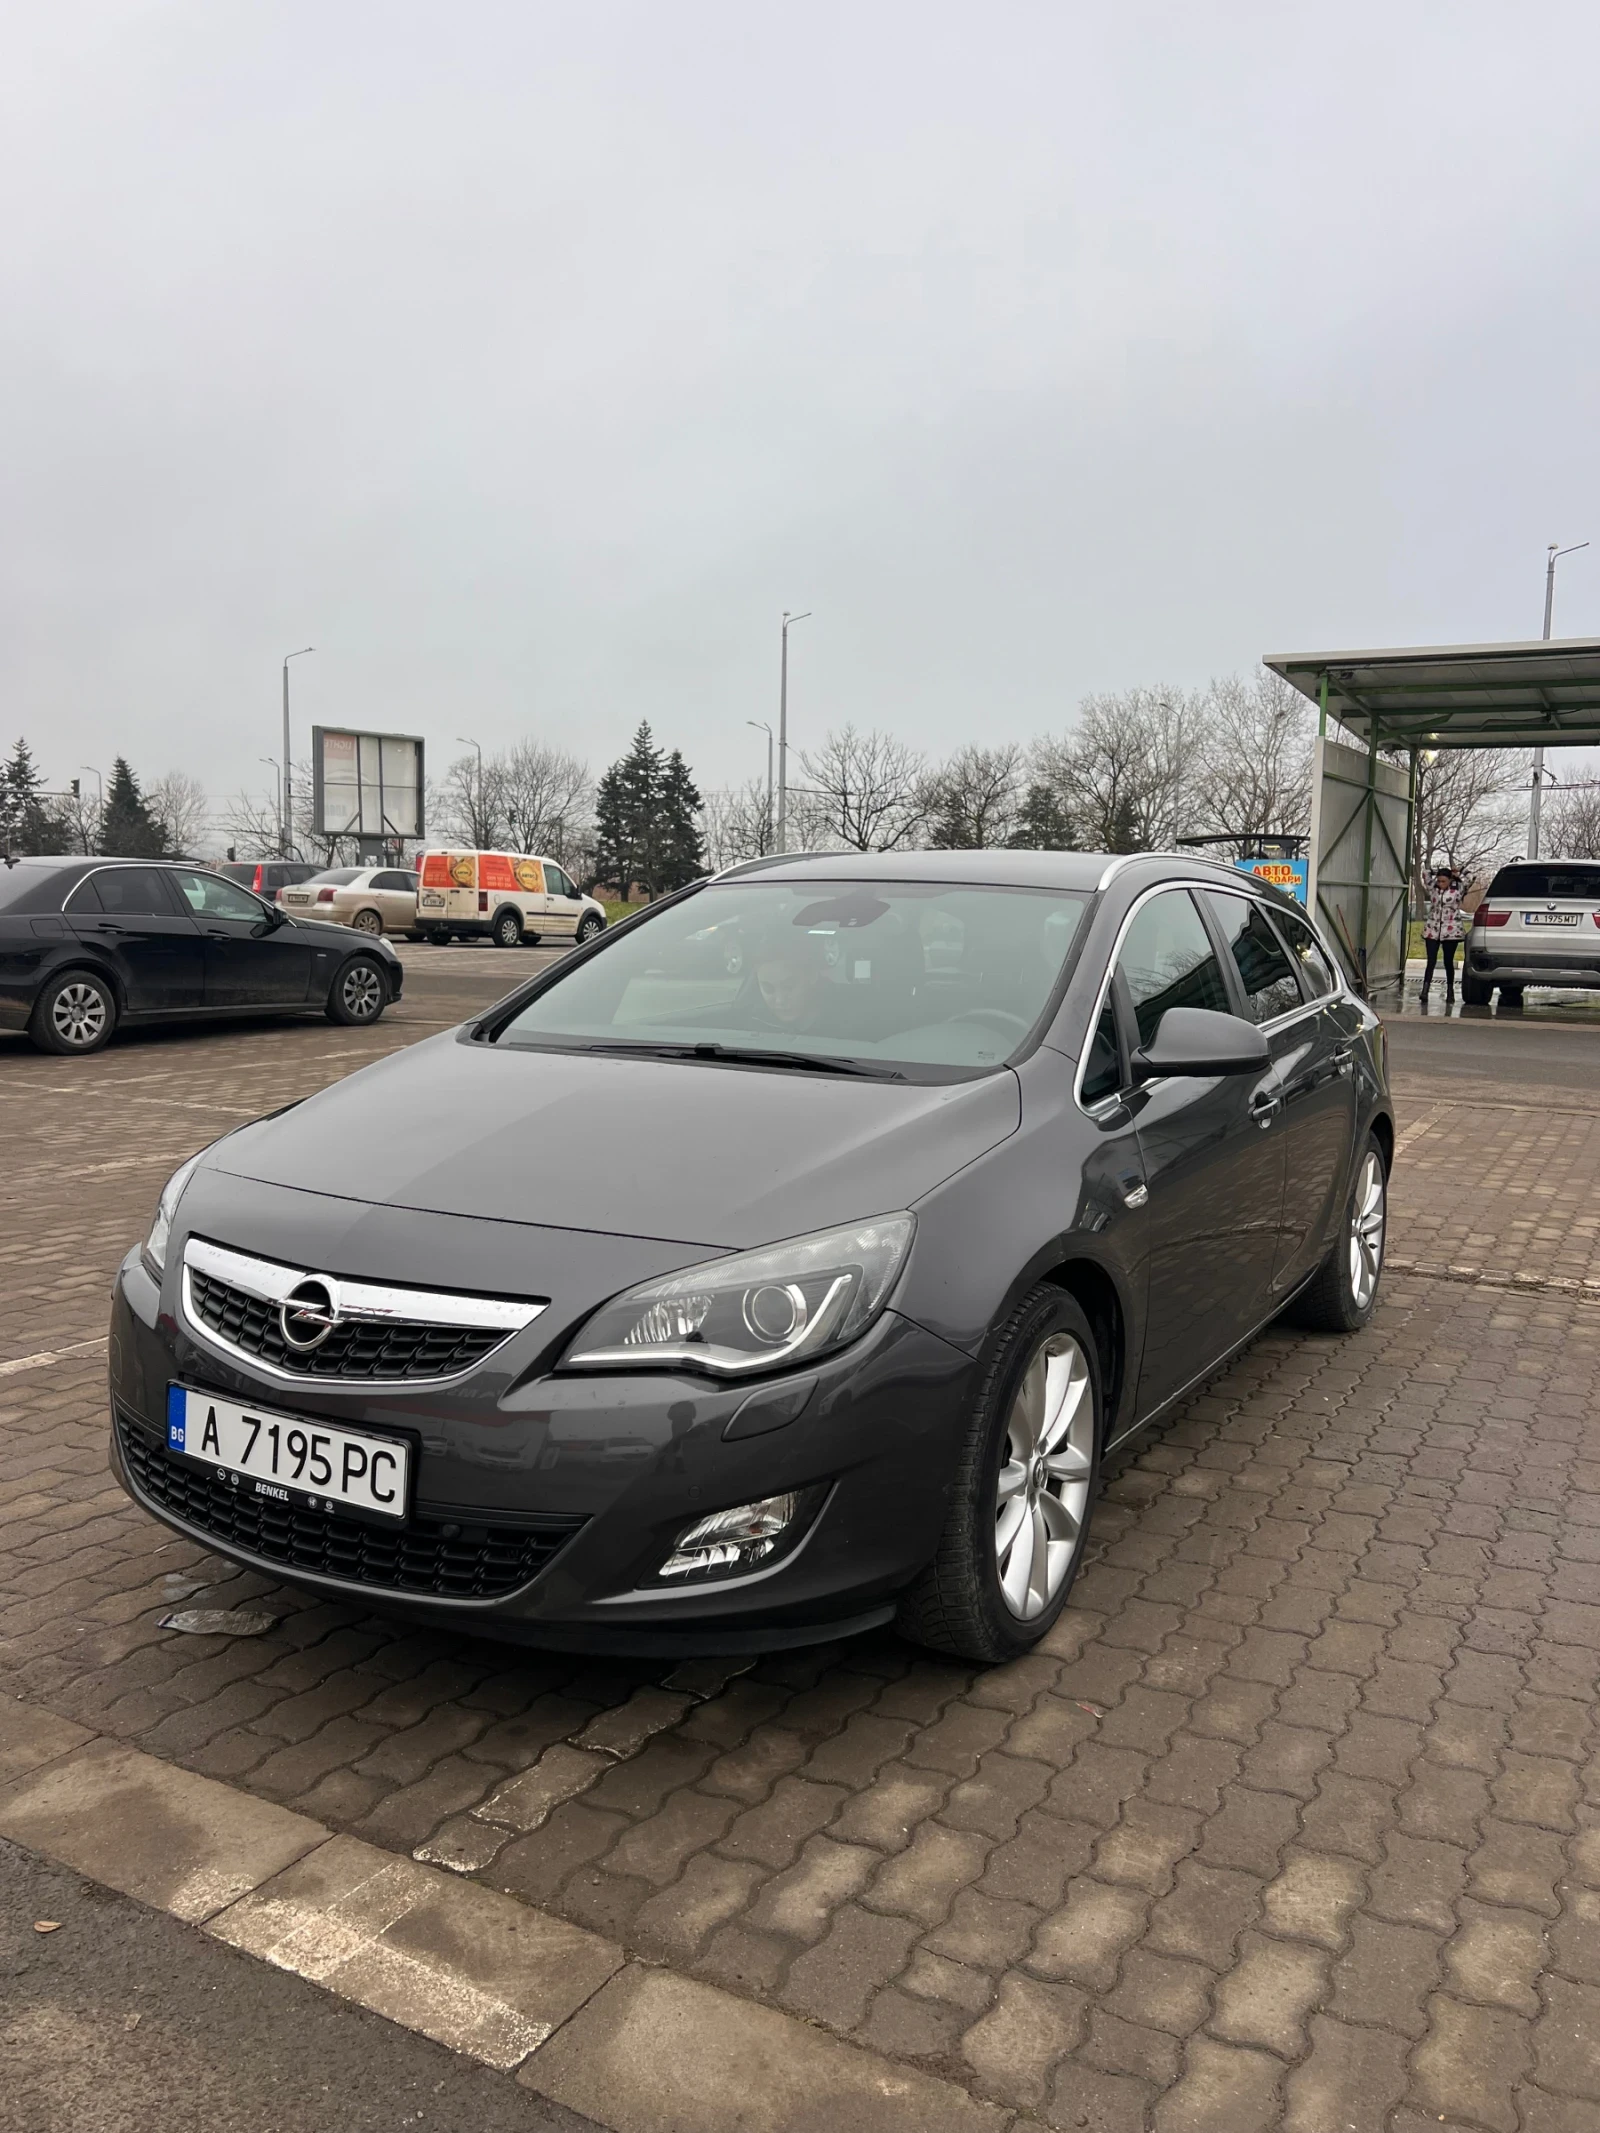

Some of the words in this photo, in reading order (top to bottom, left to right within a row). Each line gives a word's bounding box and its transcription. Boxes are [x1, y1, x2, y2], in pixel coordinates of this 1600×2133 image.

[1253, 865, 1291, 876] АВТО
[1533, 914, 1539, 922] A
[170, 1425, 185, 1443] BG
[201, 1405, 220, 1457] A
[255, 1482, 289, 1502] BENKEL
